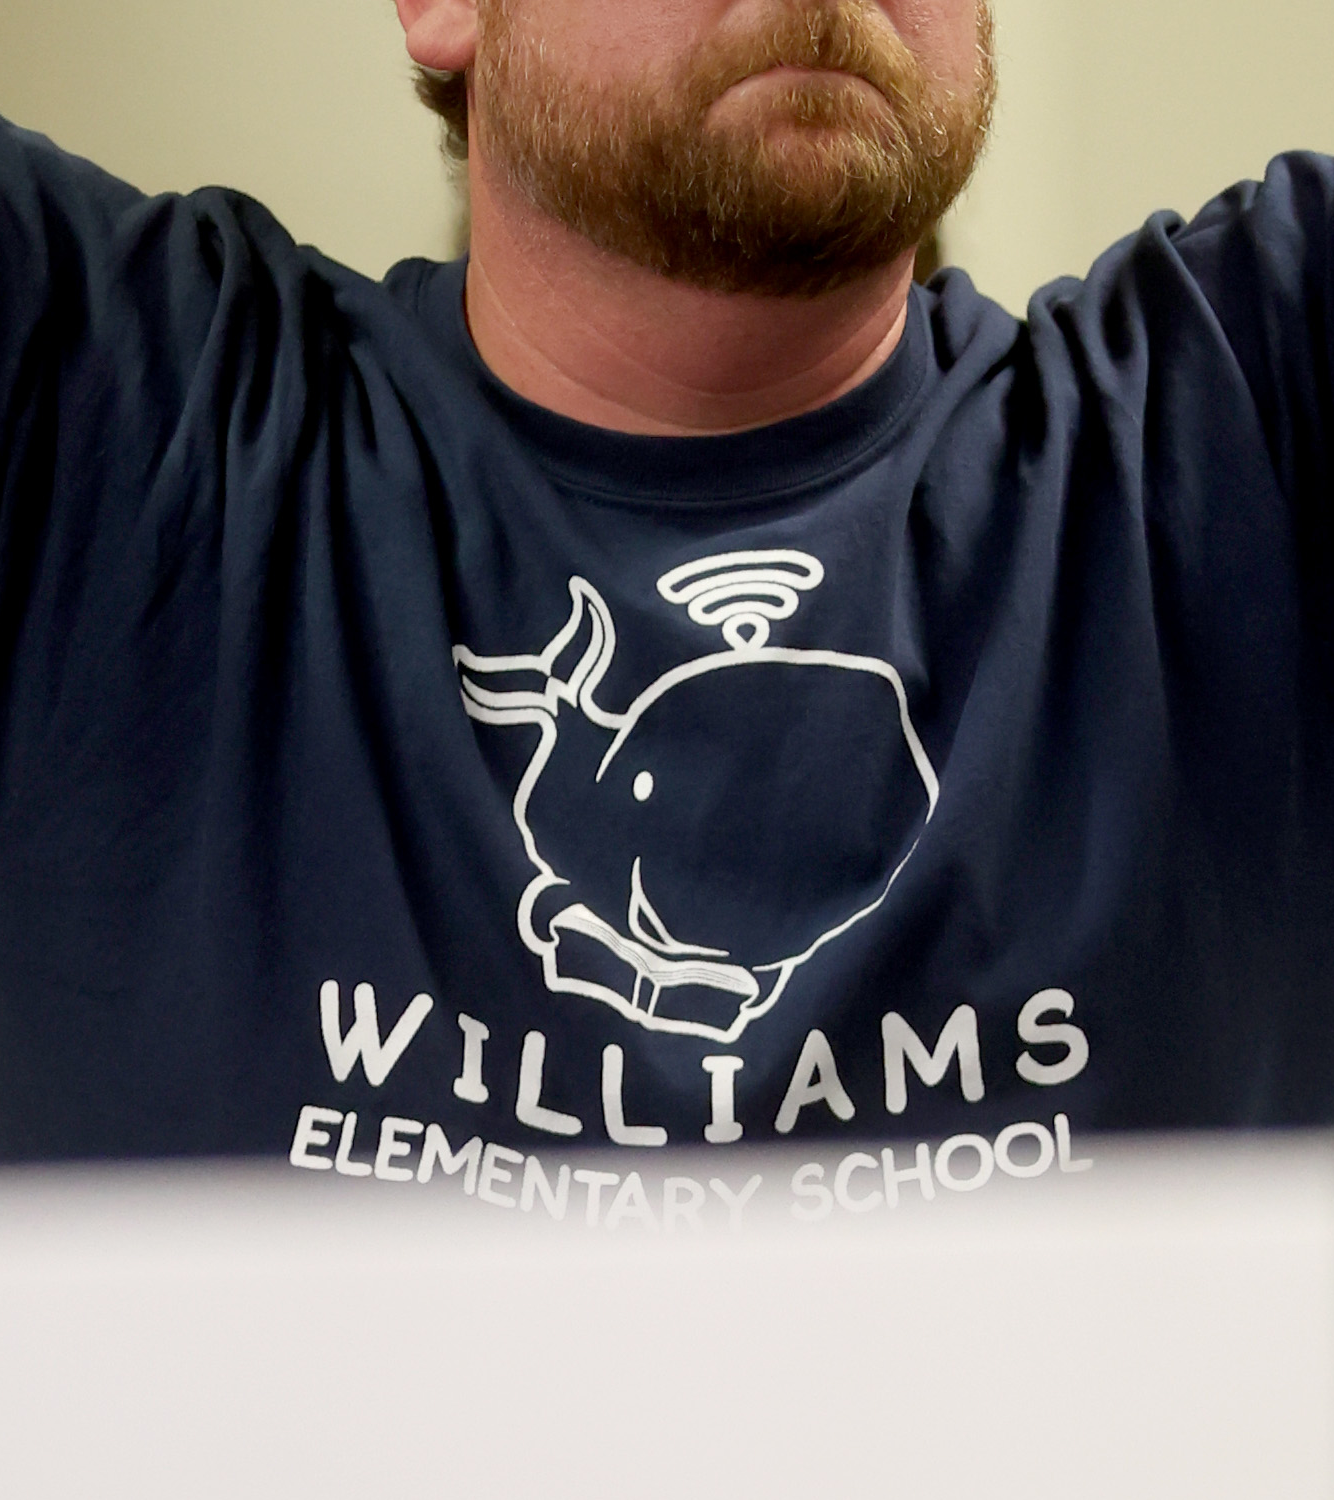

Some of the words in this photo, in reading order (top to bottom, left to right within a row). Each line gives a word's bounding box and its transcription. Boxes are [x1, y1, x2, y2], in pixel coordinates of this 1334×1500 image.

[318, 979, 1091, 1147] WILLIAMS
[288, 1104, 765, 1236] ELEMENTARY
[788, 1112, 1095, 1222] SCHOOL
